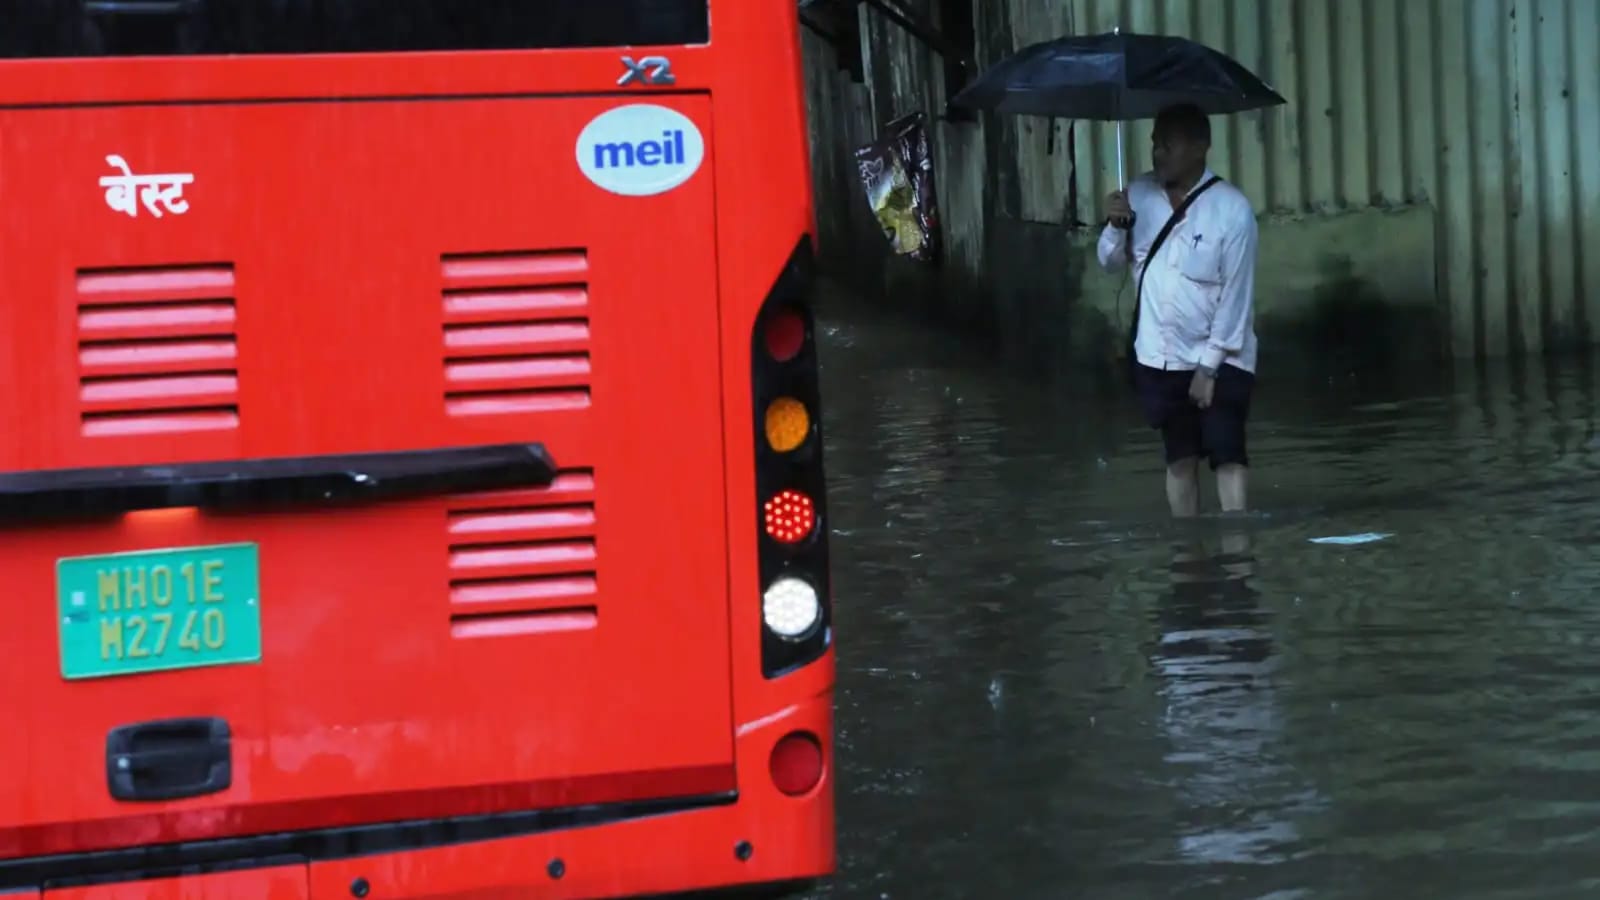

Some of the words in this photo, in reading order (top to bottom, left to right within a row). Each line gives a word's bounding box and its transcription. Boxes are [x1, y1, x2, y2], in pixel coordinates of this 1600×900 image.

[616, 56, 676, 86] X2
[594, 130, 685, 168] meil
[99, 154, 194, 218] बेस्ट
[97, 559, 224, 612] MH01E
[100, 608, 225, 660] M2740
